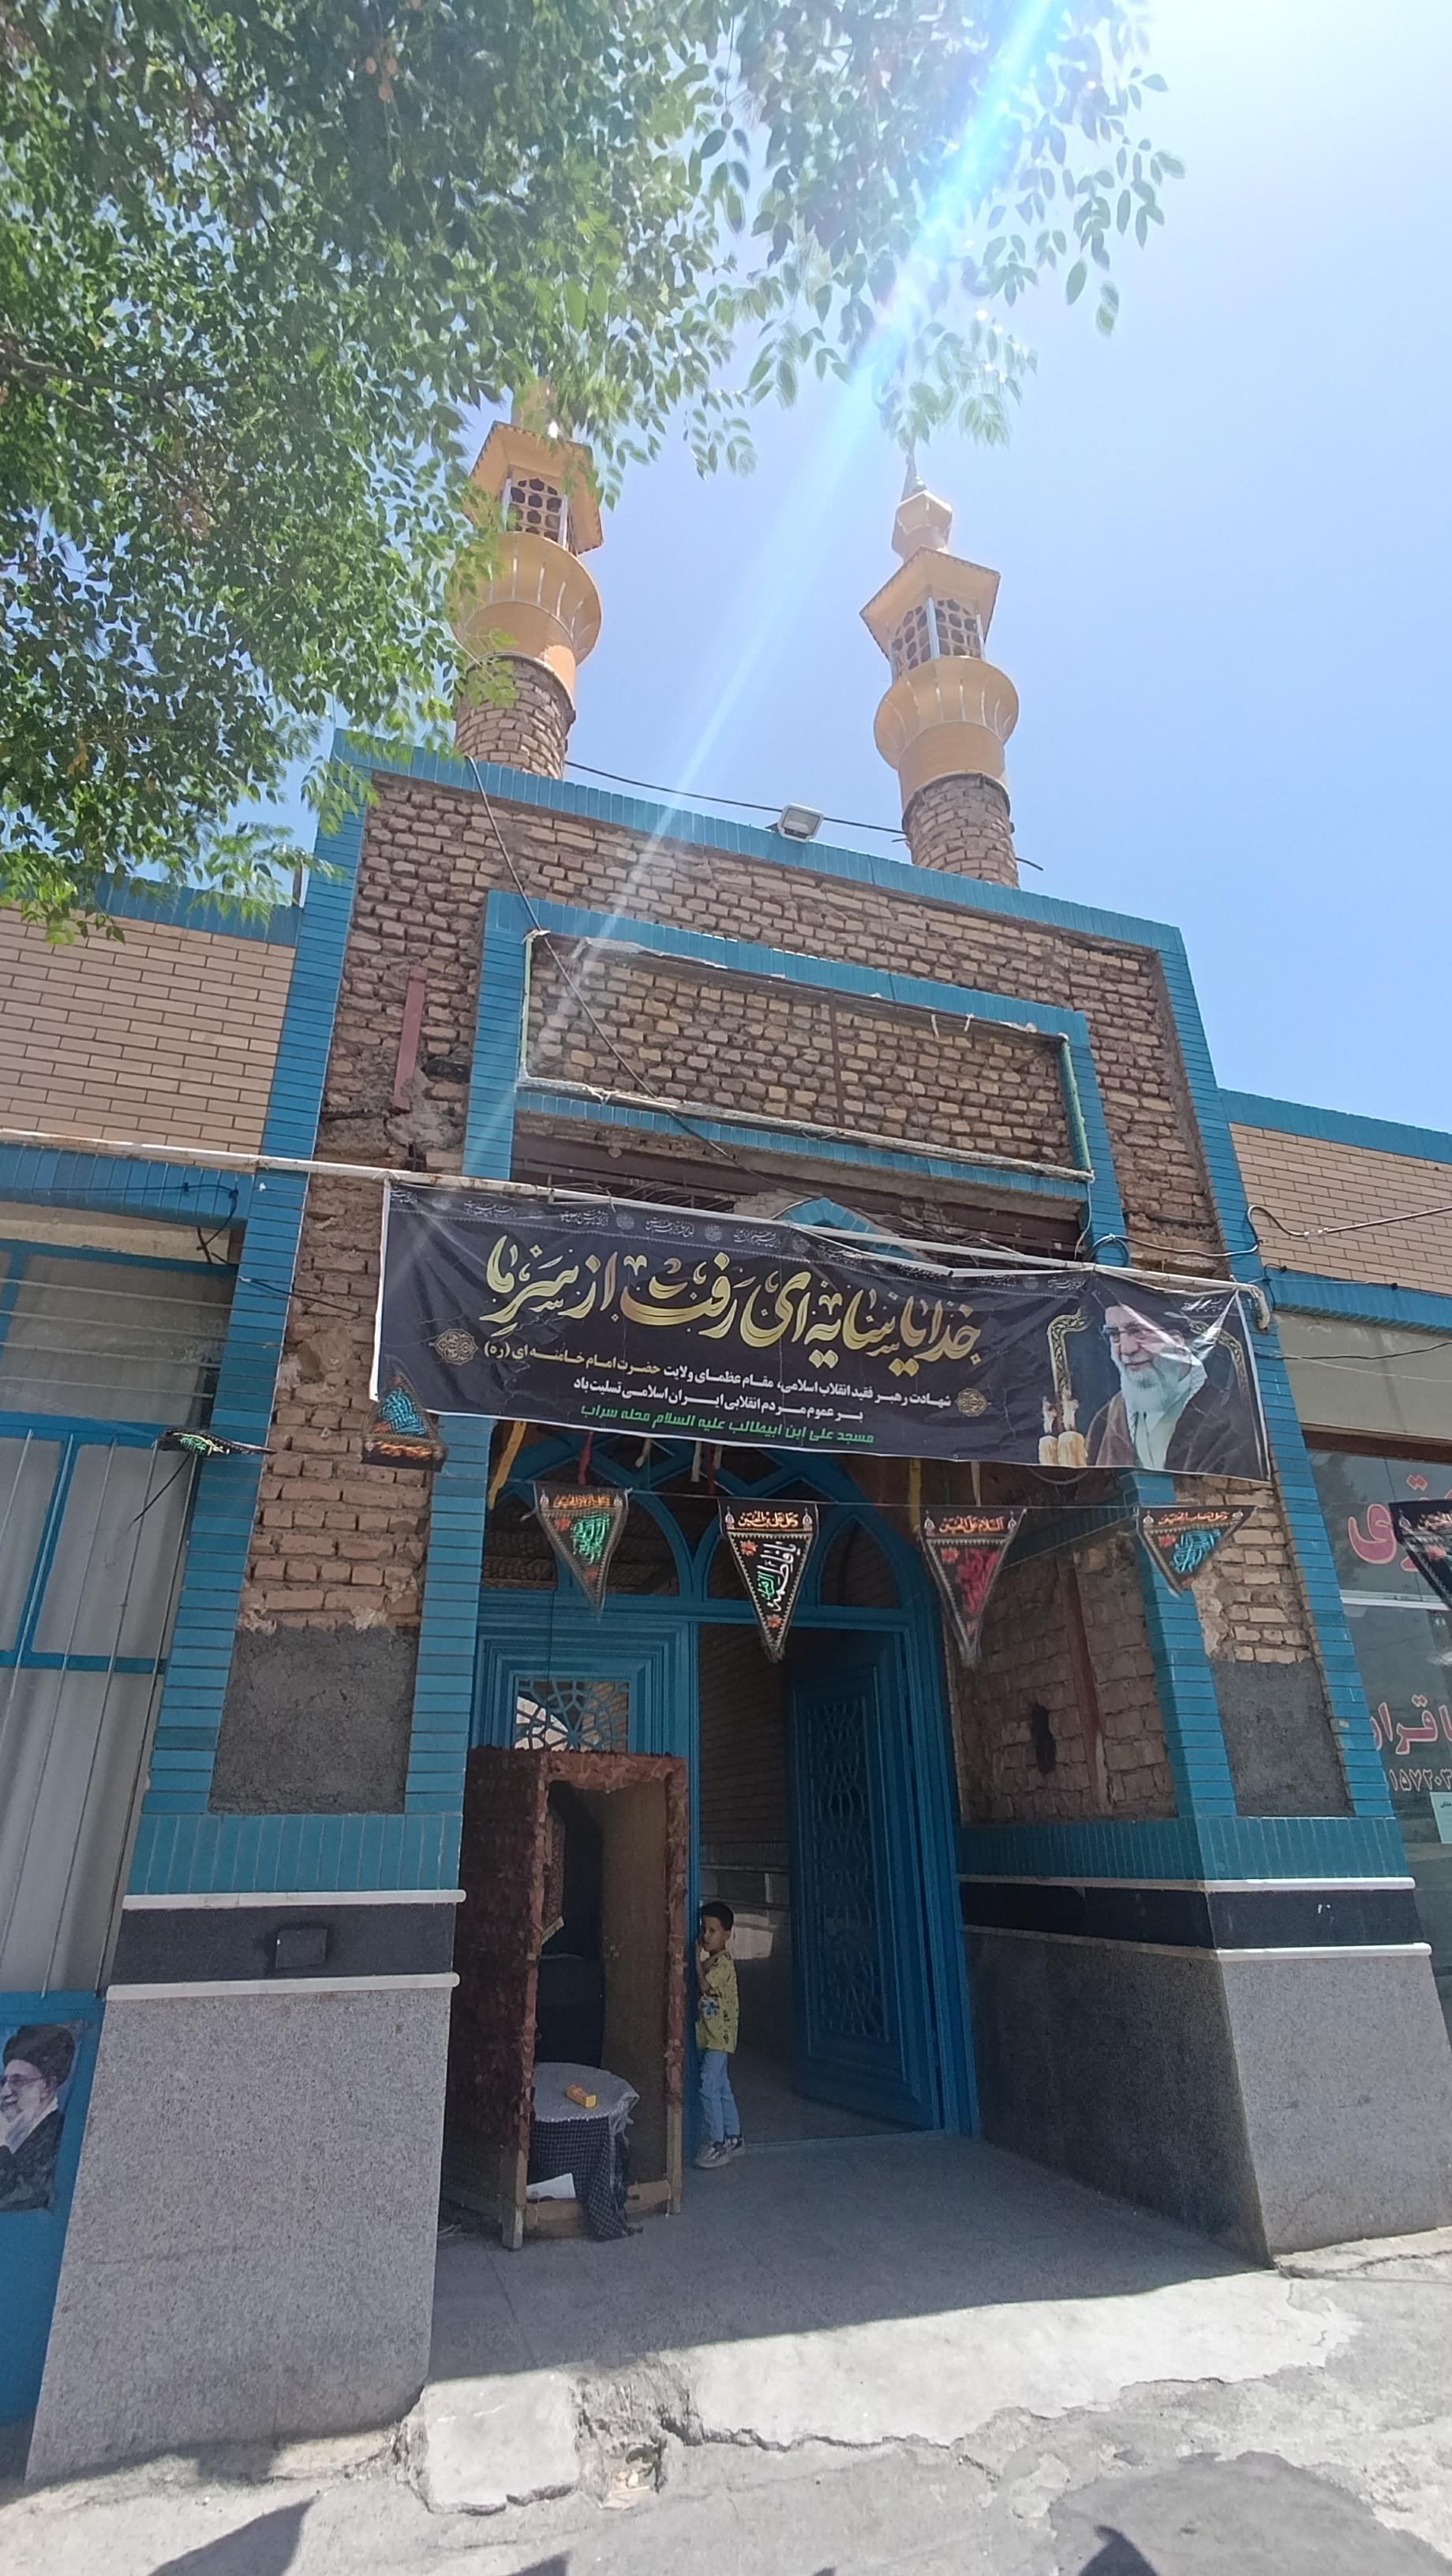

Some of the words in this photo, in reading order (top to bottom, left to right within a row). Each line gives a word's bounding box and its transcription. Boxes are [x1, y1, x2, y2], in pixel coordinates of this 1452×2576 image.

[557, 1252, 618, 1320] از
[620, 1252, 737, 1339] رفت
[889, 1296, 982, 1376] خدایا
[484, 1342, 511, 1359] (ره)
[511, 1344, 528, 1360] ای
[530, 1349, 585, 1364] خامنه
[586, 1354, 617, 1369] امام
[617, 1359, 661, 1376] حضرت
[663, 1365, 693, 1382] ولایت
[694, 1368, 741, 1384] عظمای
[742, 1373, 773, 1389] مقام
[574, 1376, 589, 1391] باد
[589, 1380, 622, 1395] تسلیت
[621, 1383, 668, 1400] اسلامی
[777, 1379, 818, 1394] اسلامی،
[819, 1382, 851, 1398] انقلاب
[668, 1388, 724, 1406] ایران
[852, 1385, 874, 1400] فقید
[874, 1391, 908, 1406] رهبر
[724, 1395, 761, 1411] انقلابی
[761, 1401, 806, 1416] مردم
[909, 1393, 952, 1409] شهادت
[581, 1405, 618, 1418] سراب
[621, 1408, 650, 1421] محله
[806, 1406, 834, 1420] عموم
[835, 1409, 863, 1424] بر
[651, 1412, 697, 1428] السلام
[698, 1417, 726, 1432] علیه
[728, 1420, 783, 1436] ابیطالب
[784, 1424, 807, 1440] ابن
[809, 1427, 834, 1442] علی
[836, 1430, 874, 1445] مسجد
